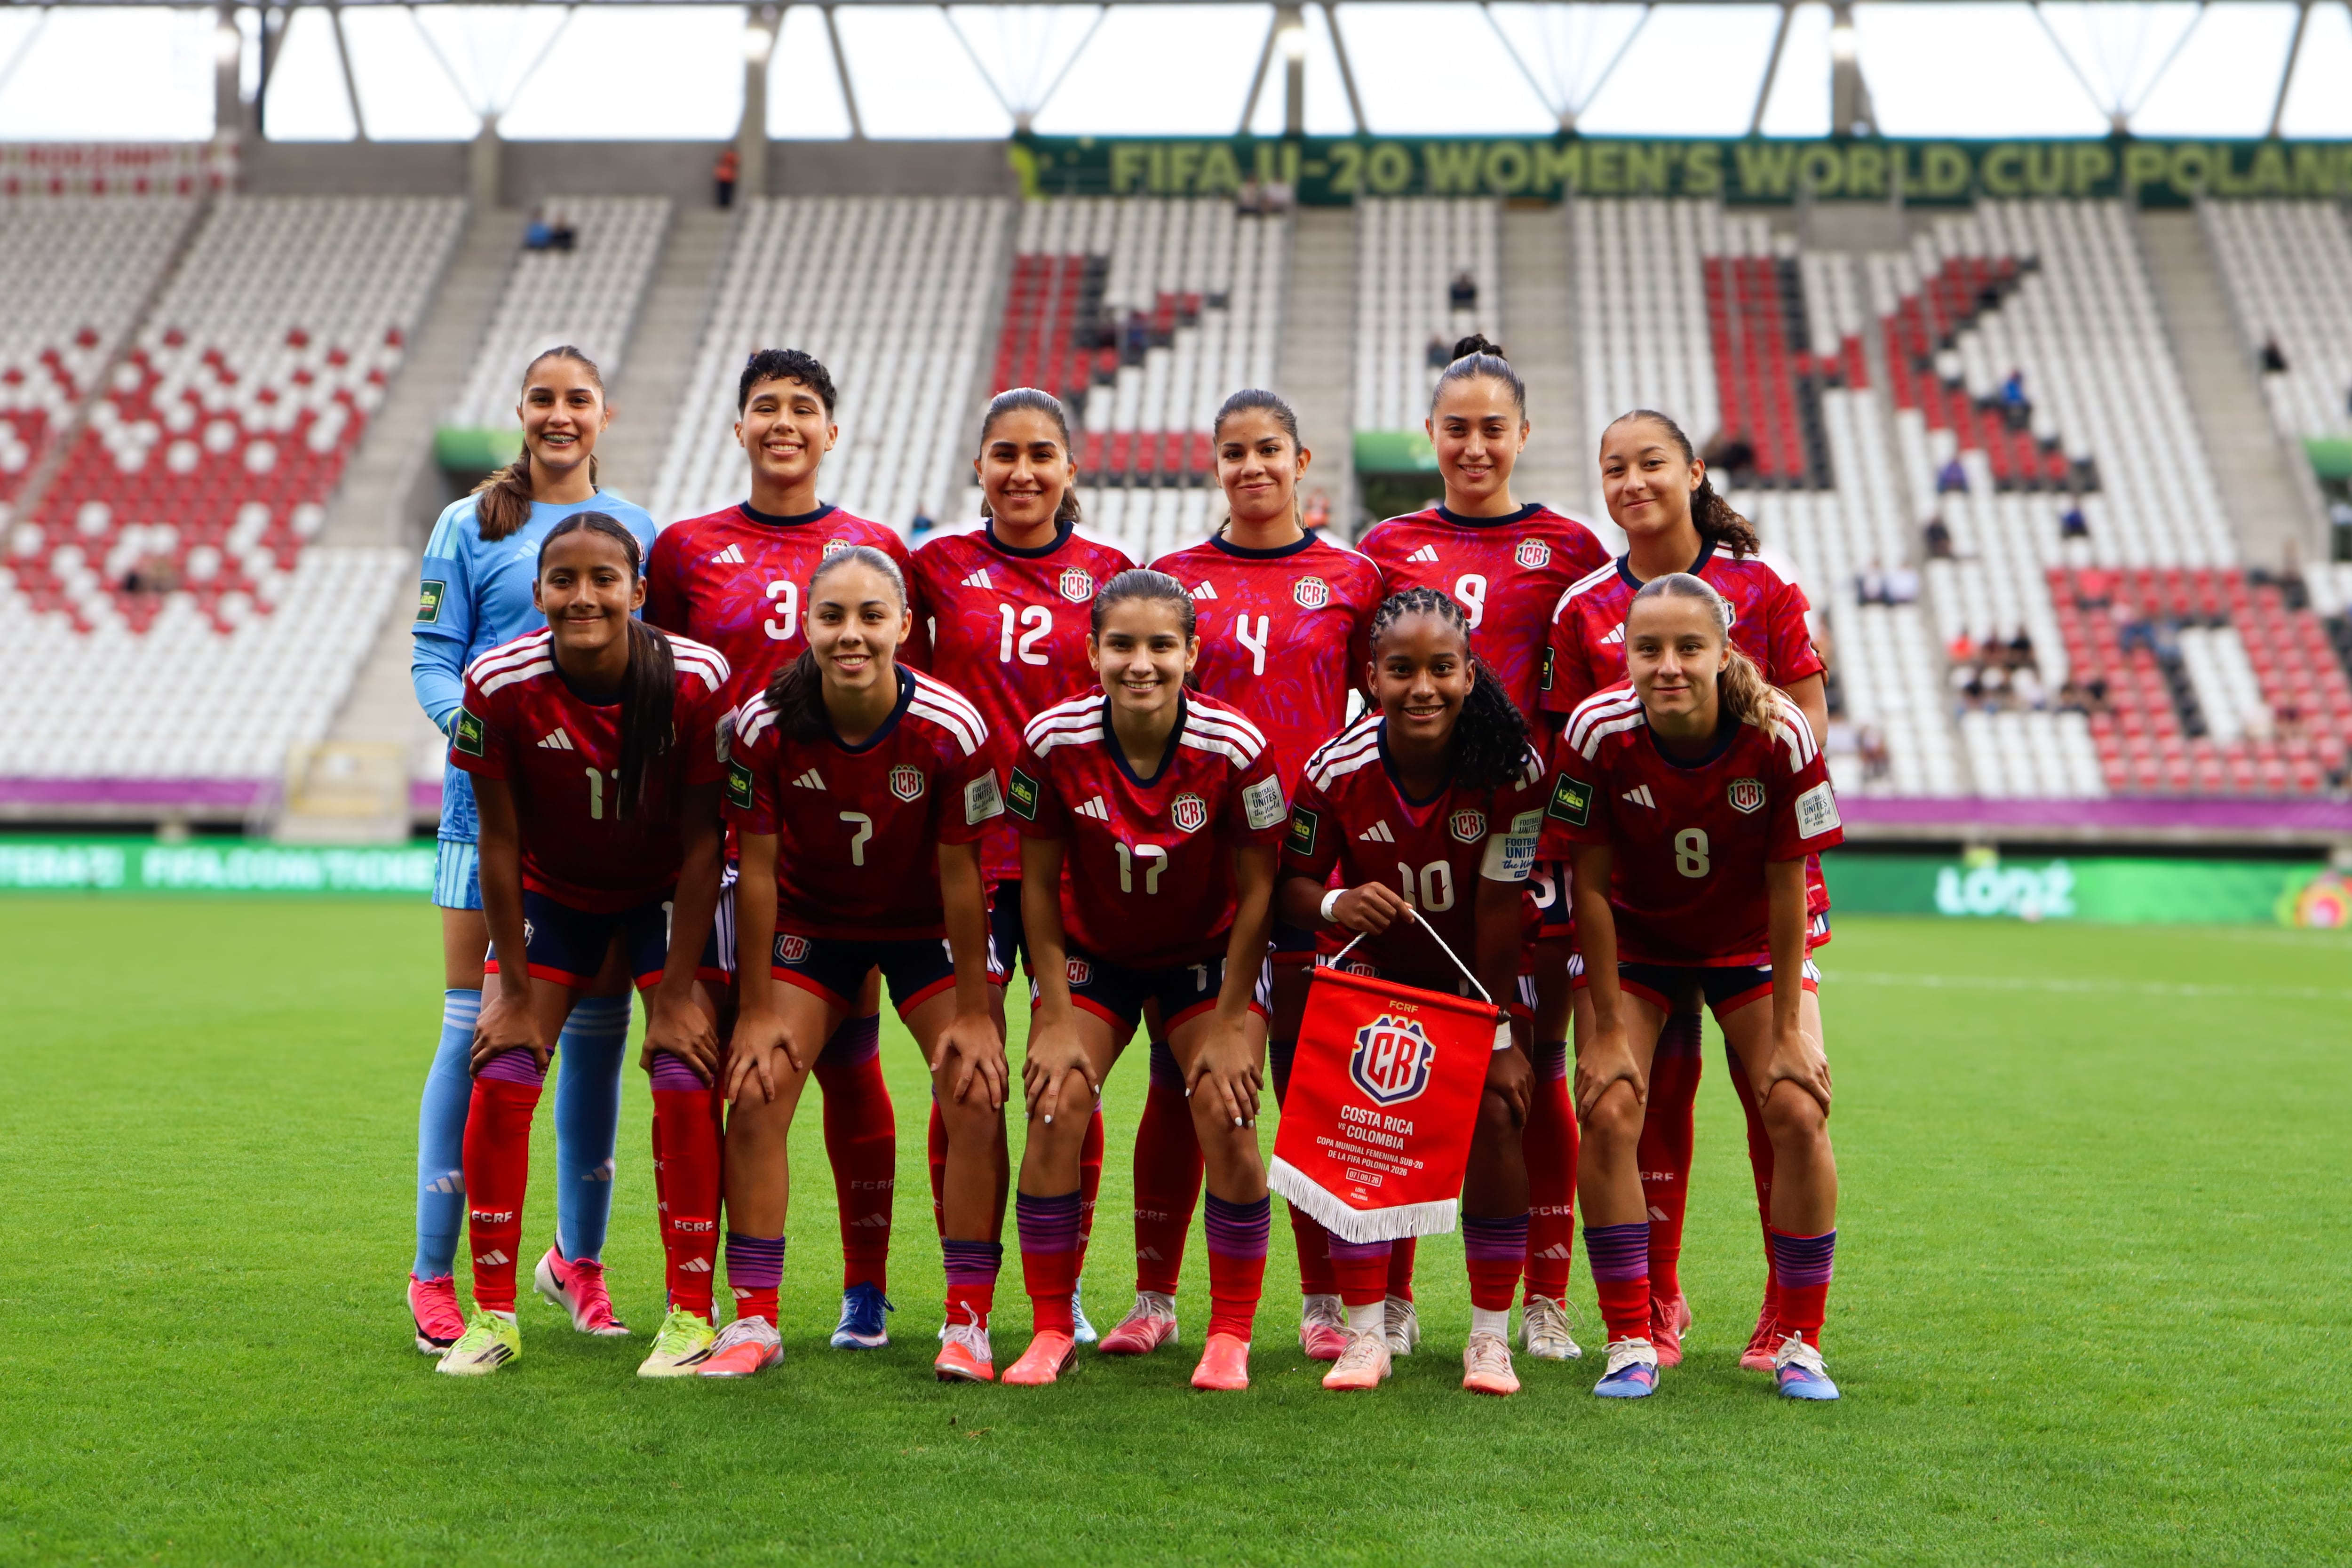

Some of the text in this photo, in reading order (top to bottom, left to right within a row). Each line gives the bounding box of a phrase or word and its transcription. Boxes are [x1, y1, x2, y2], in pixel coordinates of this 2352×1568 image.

[1110, 144, 2352, 191] FIFA U-20 WOMEN'S WORLD CUP POLAN
[1524, 547, 1543, 564] CR
[1068, 576, 1087, 596] CR
[1303, 585, 1322, 604] CR
[764, 580, 797, 640] 3
[1455, 573, 1487, 630] 9
[999, 603, 1052, 665] 12
[1236, 614, 1270, 676] 4
[898, 772, 916, 794] CR
[972, 779, 992, 793] FOOTBALL
[1251, 785, 1274, 799] FOOTBALL
[973, 787, 992, 802] UNITES
[1253, 791, 1276, 808] UNITES
[1736, 784, 1757, 806] CR
[1803, 792, 1825, 807] FOOTBALL
[1179, 802, 1199, 825] CR
[1265, 800, 1280, 813] World
[1804, 799, 1827, 815] UNITES
[1804, 807, 1831, 825] the World
[1459, 814, 1479, 837] CR
[840, 812, 873, 866] 7
[1506, 847, 1537, 859] UNITE
[1675, 828, 1709, 877] 8
[1115, 842, 1168, 894] 17
[1502, 860, 1518, 869] the
[1398, 860, 1454, 912] 10
[781, 936, 804, 959] CR
[1067, 962, 1088, 982] CR
[1389, 1000, 1419, 1013] FCRF
[1367, 1032, 1417, 1090] CR
[1341, 1105, 1413, 1136] COSTA RICA
[1346, 1125, 1404, 1150] COLOMBIA
[1317, 1136, 1424, 1170] COPA MUNDIAL FEMENINA SUB-20
[1328, 1150, 1408, 1177] DE LA FIFA POLONIA 2026
[472, 1210, 512, 1223] FCRF
[675, 1220, 713, 1232] FCRF
